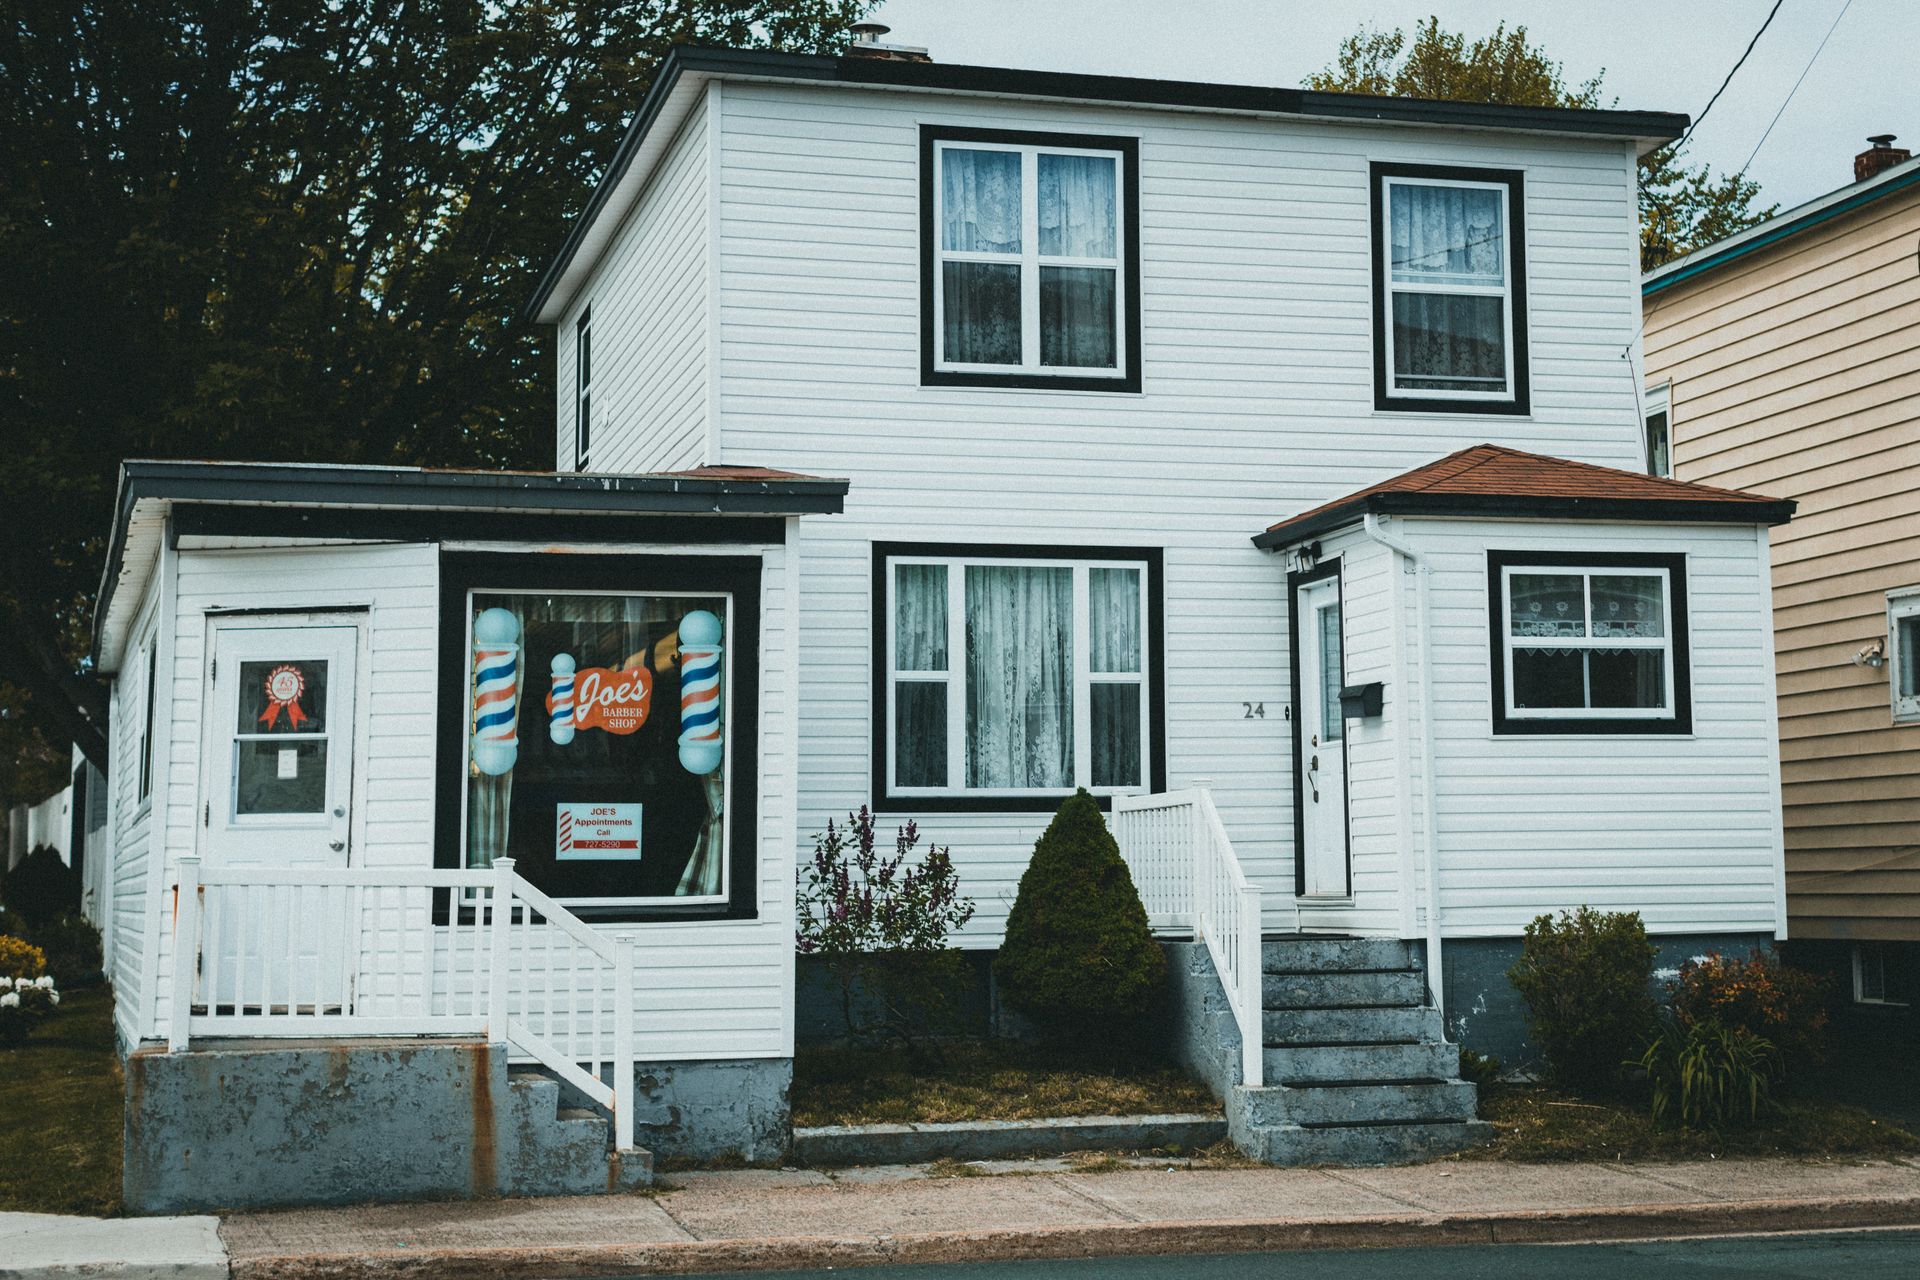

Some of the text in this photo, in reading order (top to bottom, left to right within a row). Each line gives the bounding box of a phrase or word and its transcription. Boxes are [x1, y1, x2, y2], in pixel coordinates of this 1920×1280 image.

[575, 670, 648, 722] Joe's
[602, 707, 643, 718] BARBER
[1242, 702, 1265, 719] 24
[608, 718, 637, 729] SHOP
[590, 807, 617, 816] JOE'S
[574, 818, 633, 827] Appointments
